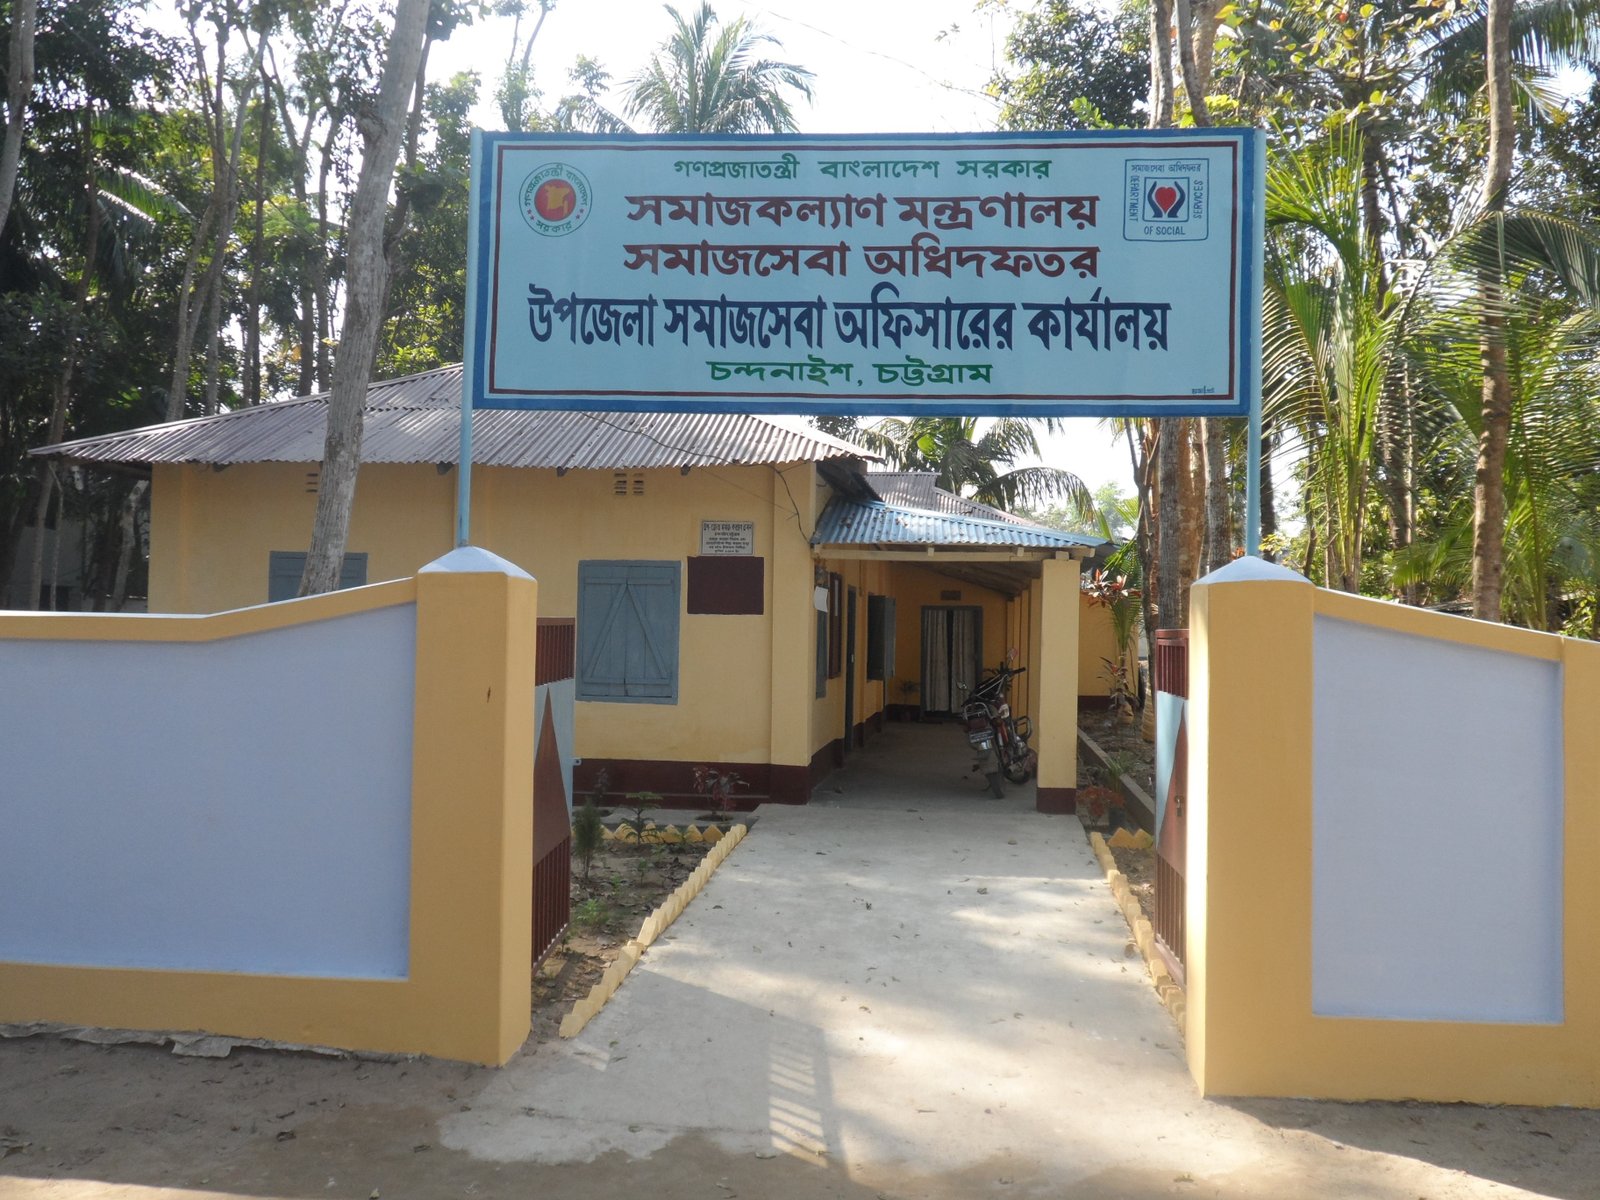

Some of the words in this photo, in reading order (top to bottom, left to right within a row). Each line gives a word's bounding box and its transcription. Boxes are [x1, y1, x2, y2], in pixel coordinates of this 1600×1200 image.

[674, 153, 800, 180] গণপ্রজাতন্ত্রী
[817, 160, 940, 179] বাংলাদেশ
[956, 160, 1052, 180] সরকার
[624, 192, 887, 229] সমাজকল্যাণ
[893, 191, 1100, 231] মন্ত্রণালয়
[1129, 175, 1140, 222] DEPARTMENT
[1193, 179, 1204, 220] SERVICES
[536, 219, 573, 233] সরকার
[1144, 226, 1154, 235] OF
[1156, 226, 1186, 235] SOCIAL
[623, 239, 851, 277] সমাজসেবা
[862, 232, 1101, 279] অধিদফতর
[527, 283, 658, 347] উপজেলা
[662, 293, 828, 349] সমাজসেবা
[833, 281, 1018, 350] অফিসারের
[1021, 286, 1172, 351] কার্যালয়
[705, 354, 864, 386] চন্দনাইশ,
[872, 354, 994, 387] চট্টগ্রাম
